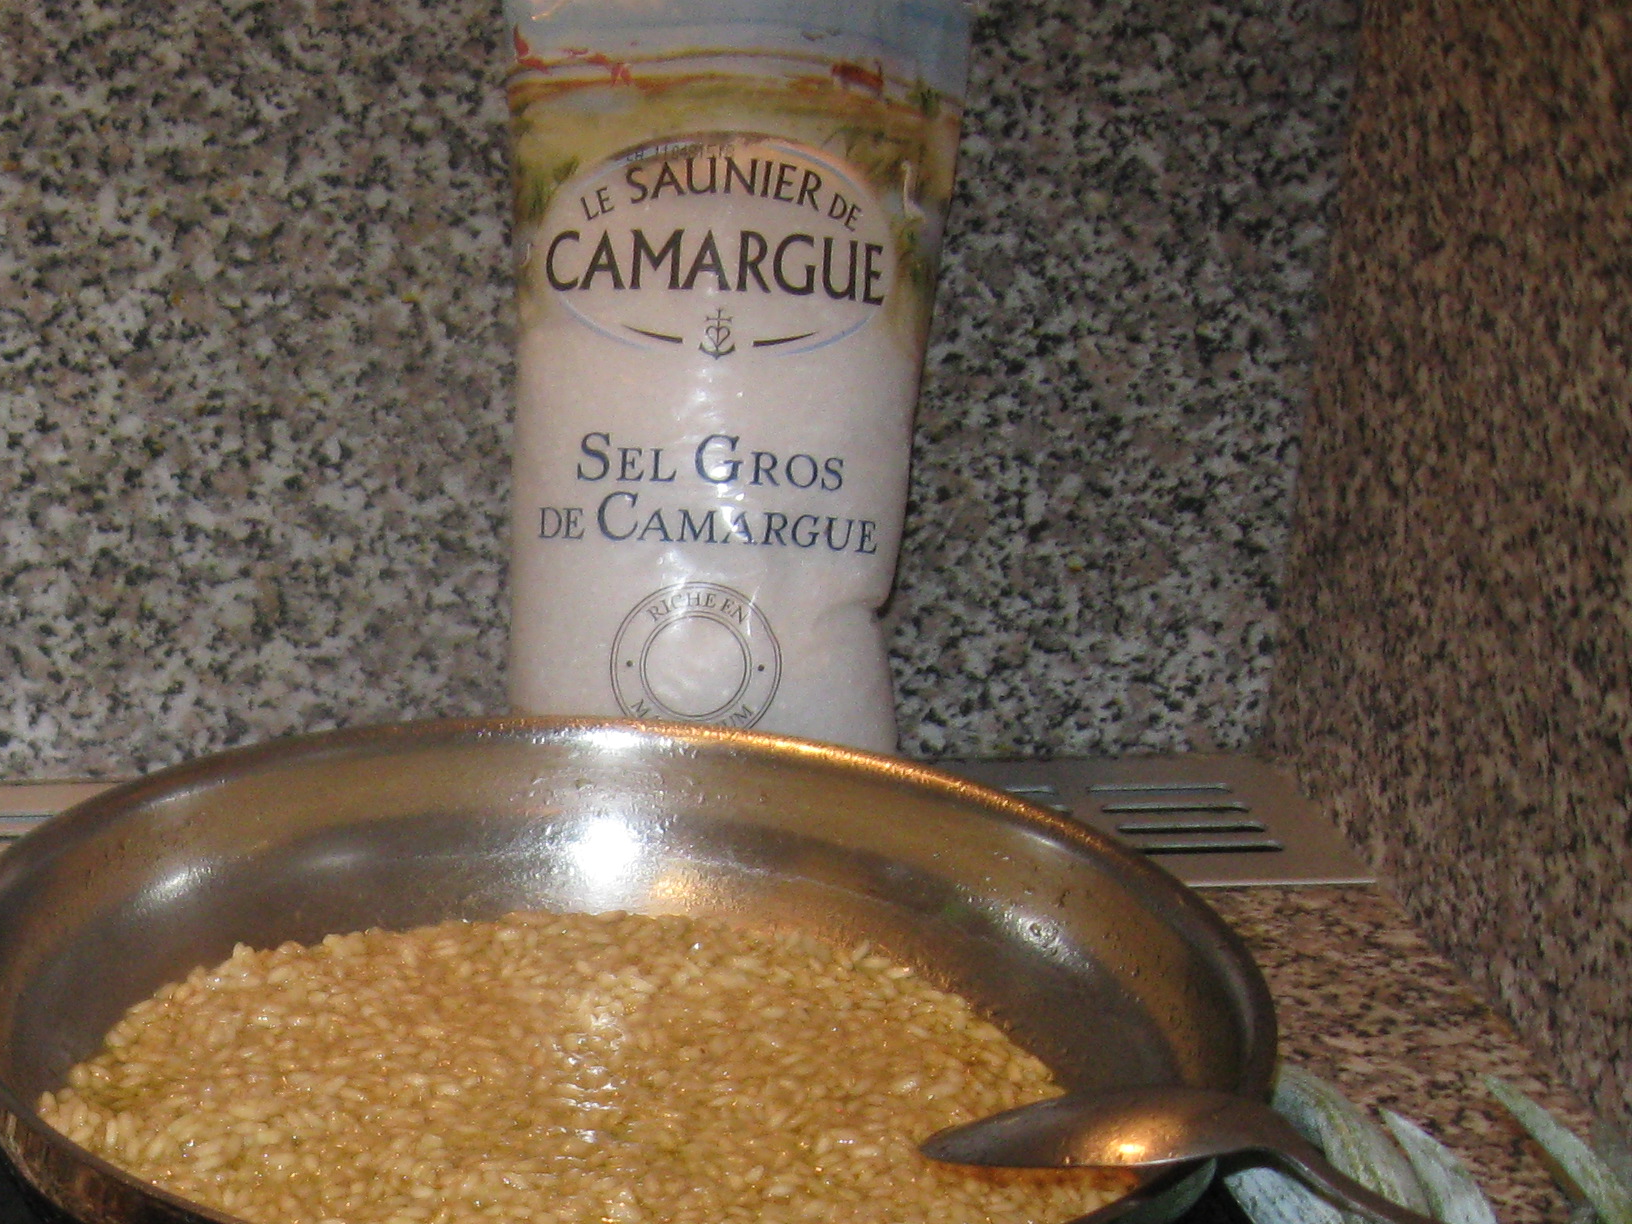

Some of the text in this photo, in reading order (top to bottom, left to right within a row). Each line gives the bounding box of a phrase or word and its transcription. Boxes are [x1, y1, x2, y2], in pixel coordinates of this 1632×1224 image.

[580, 156, 863, 231] LE SAUNIER DE
[545, 228, 886, 306] CAMARGUE
[576, 432, 846, 491] SEL GROS
[539, 491, 878, 556] DE CAMARGUE
[645, 592, 750, 624] RICHE EN
